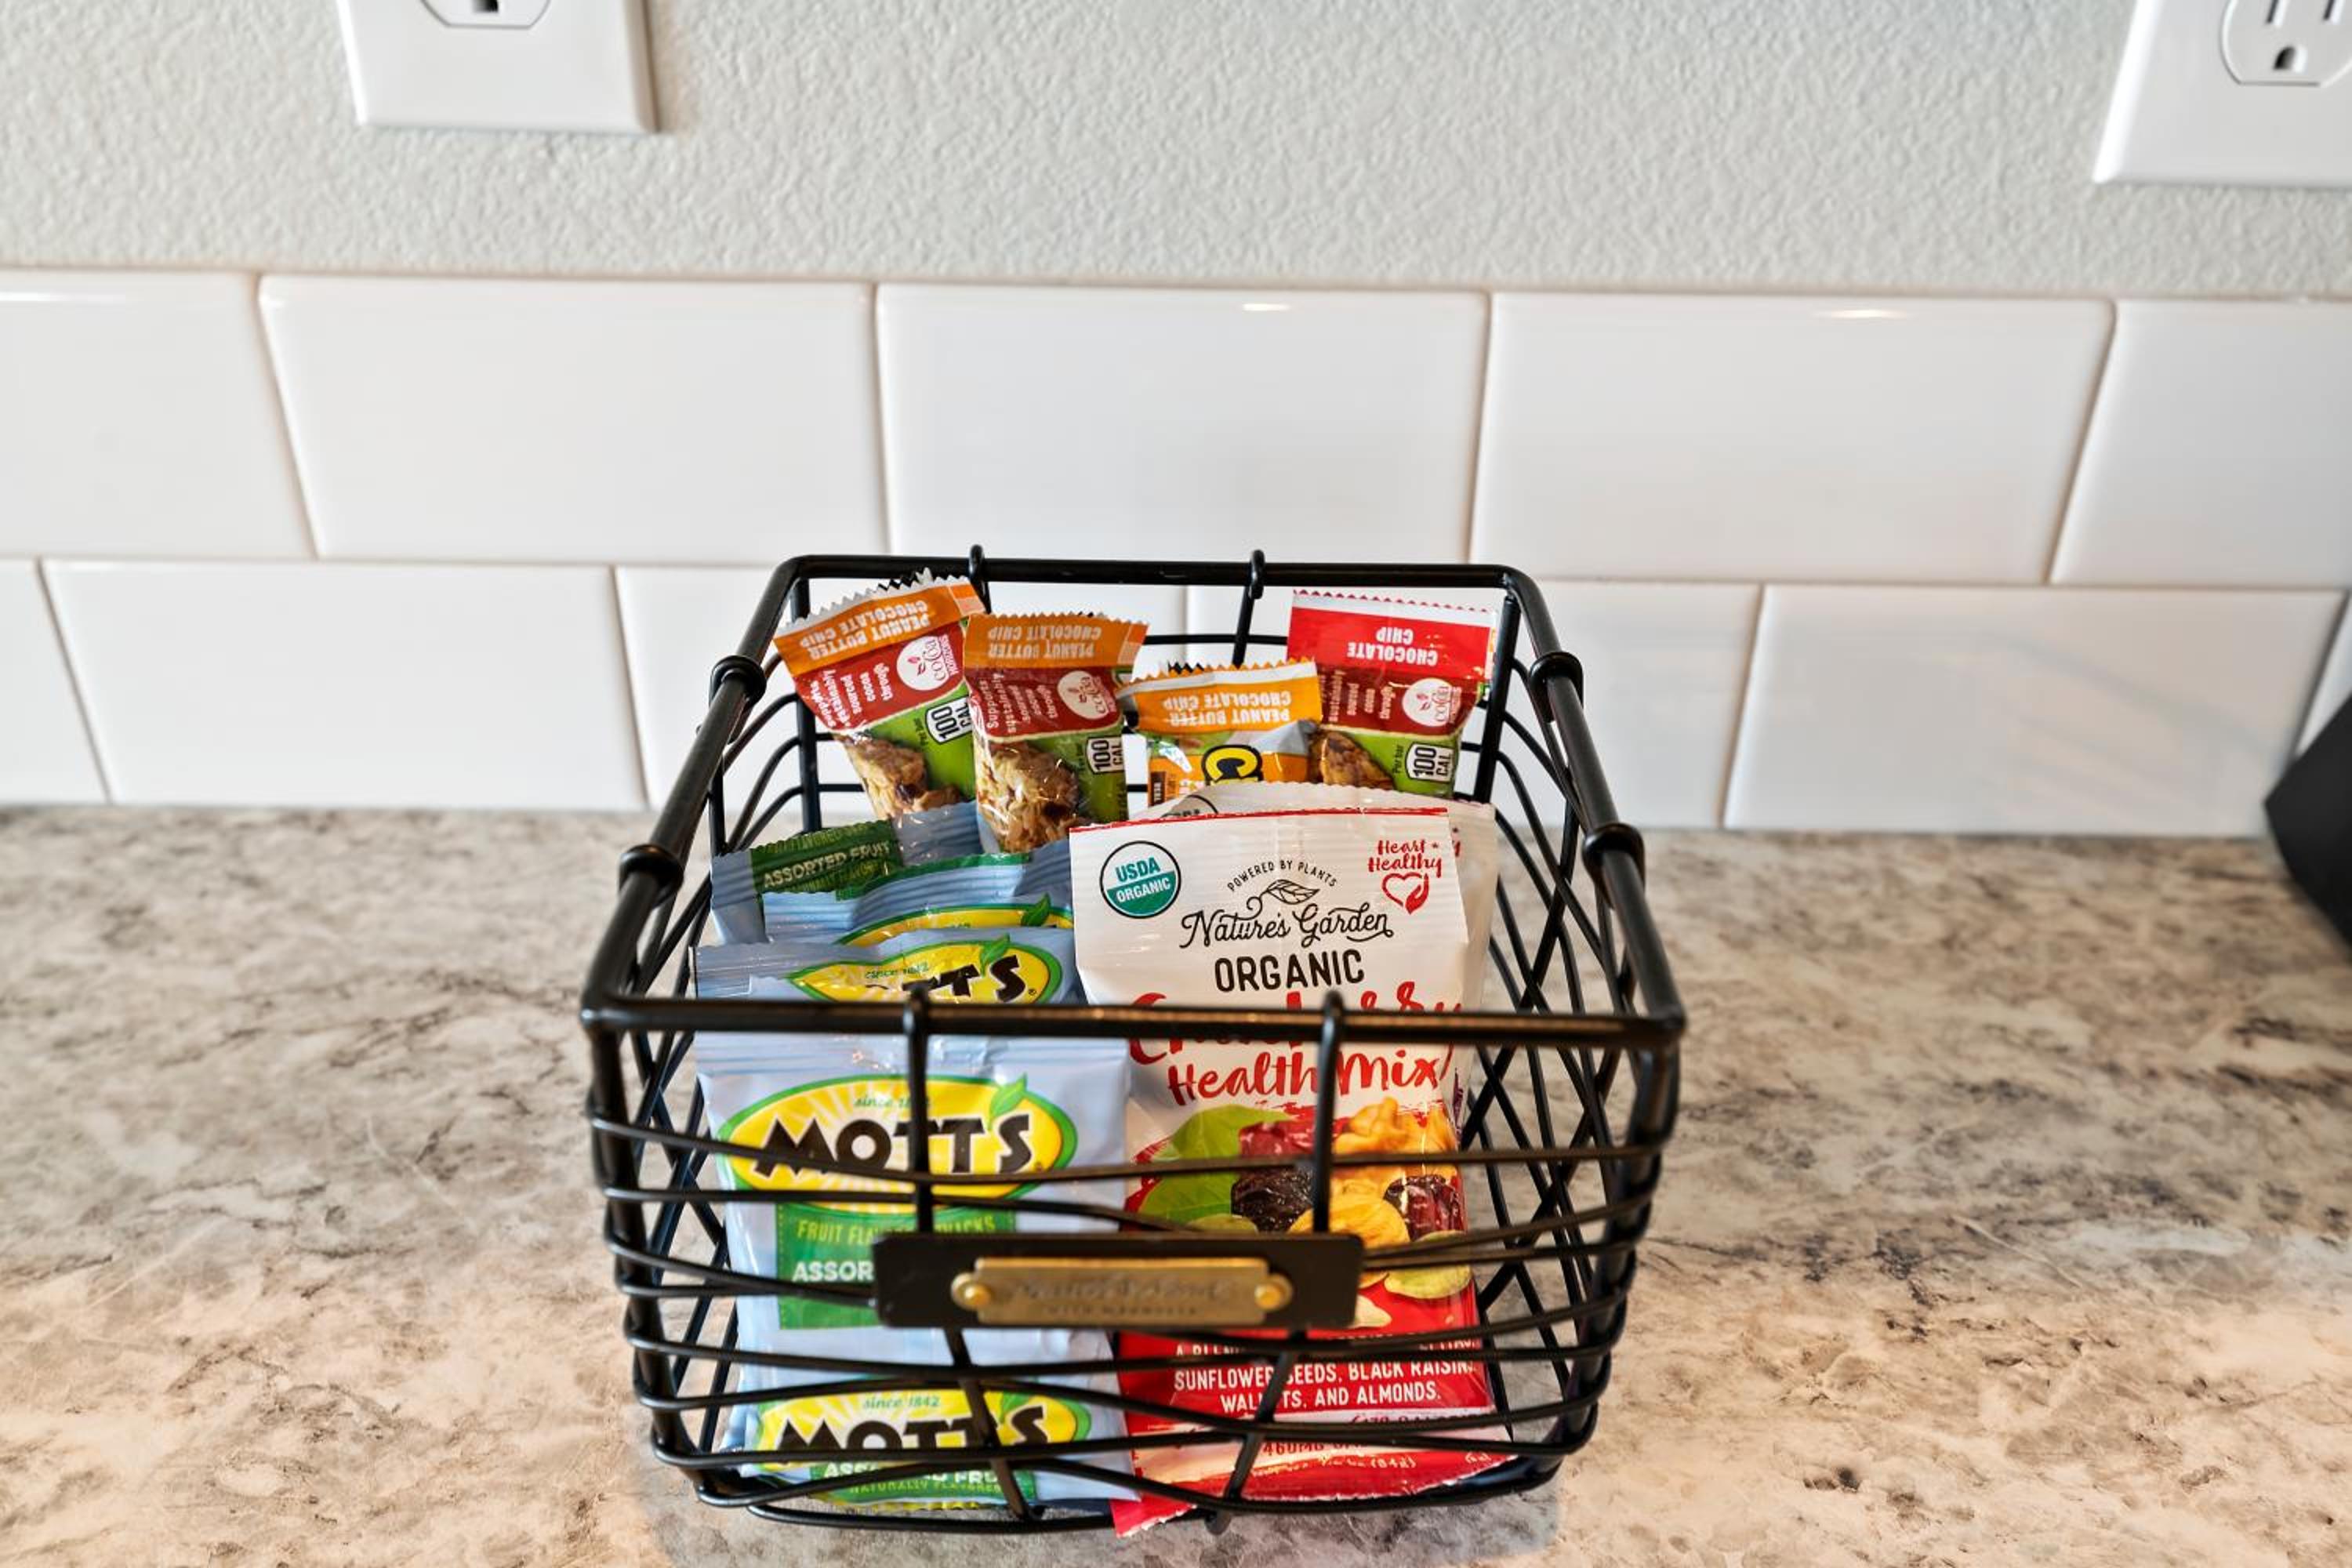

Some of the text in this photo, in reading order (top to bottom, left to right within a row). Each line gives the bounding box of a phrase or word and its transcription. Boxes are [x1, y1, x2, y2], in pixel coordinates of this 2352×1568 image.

[800, 600, 929, 648] CHOCOLATE CHIP
[988, 626, 1102, 641] CHOCOLATE CHIP
[1376, 626, 1414, 644] CHIP
[808, 614, 931, 661] PEANUT BUTTER
[988, 640, 1094, 660] PEANUT BUTTER
[1347, 641, 1439, 666] CHOCOLATE
[980, 679, 1000, 729] Supports
[1163, 690, 1291, 712] CHOCOLATE CHIP
[931, 706, 960, 739] 100
[955, 702, 972, 728] CAL
[1232, 708, 1290, 724] PEANUT
[1091, 739, 1111, 771] 100
[1112, 745, 1123, 766] CAL
[1413, 746, 1438, 777] 100
[1436, 753, 1451, 778] CAL
[1377, 839, 1425, 855] Heart
[763, 851, 848, 888] ASSORTED
[849, 841, 891, 861] FRUIT
[1115, 856, 1161, 883] USDA
[1227, 860, 1338, 892] POWERED BY PLANTS
[1367, 852, 1443, 878] Healthy
[1116, 877, 1171, 903] ORGANIC
[1179, 902, 1394, 949] Nature's Garden
[1214, 949, 1365, 993] ORGANIC
[1167, 1049, 1440, 1107] Health Mix
[797, 1219, 842, 1243] FRUIT
[792, 1261, 874, 1283] ASSOR
[1174, 1366, 1275, 1392] SUNFLOWER
[1348, 1361, 1404, 1381] BLACK
[862, 1395, 941, 1410] since 1842
[1219, 1380, 1442, 1414] WALTS, AND ALMONDS.
